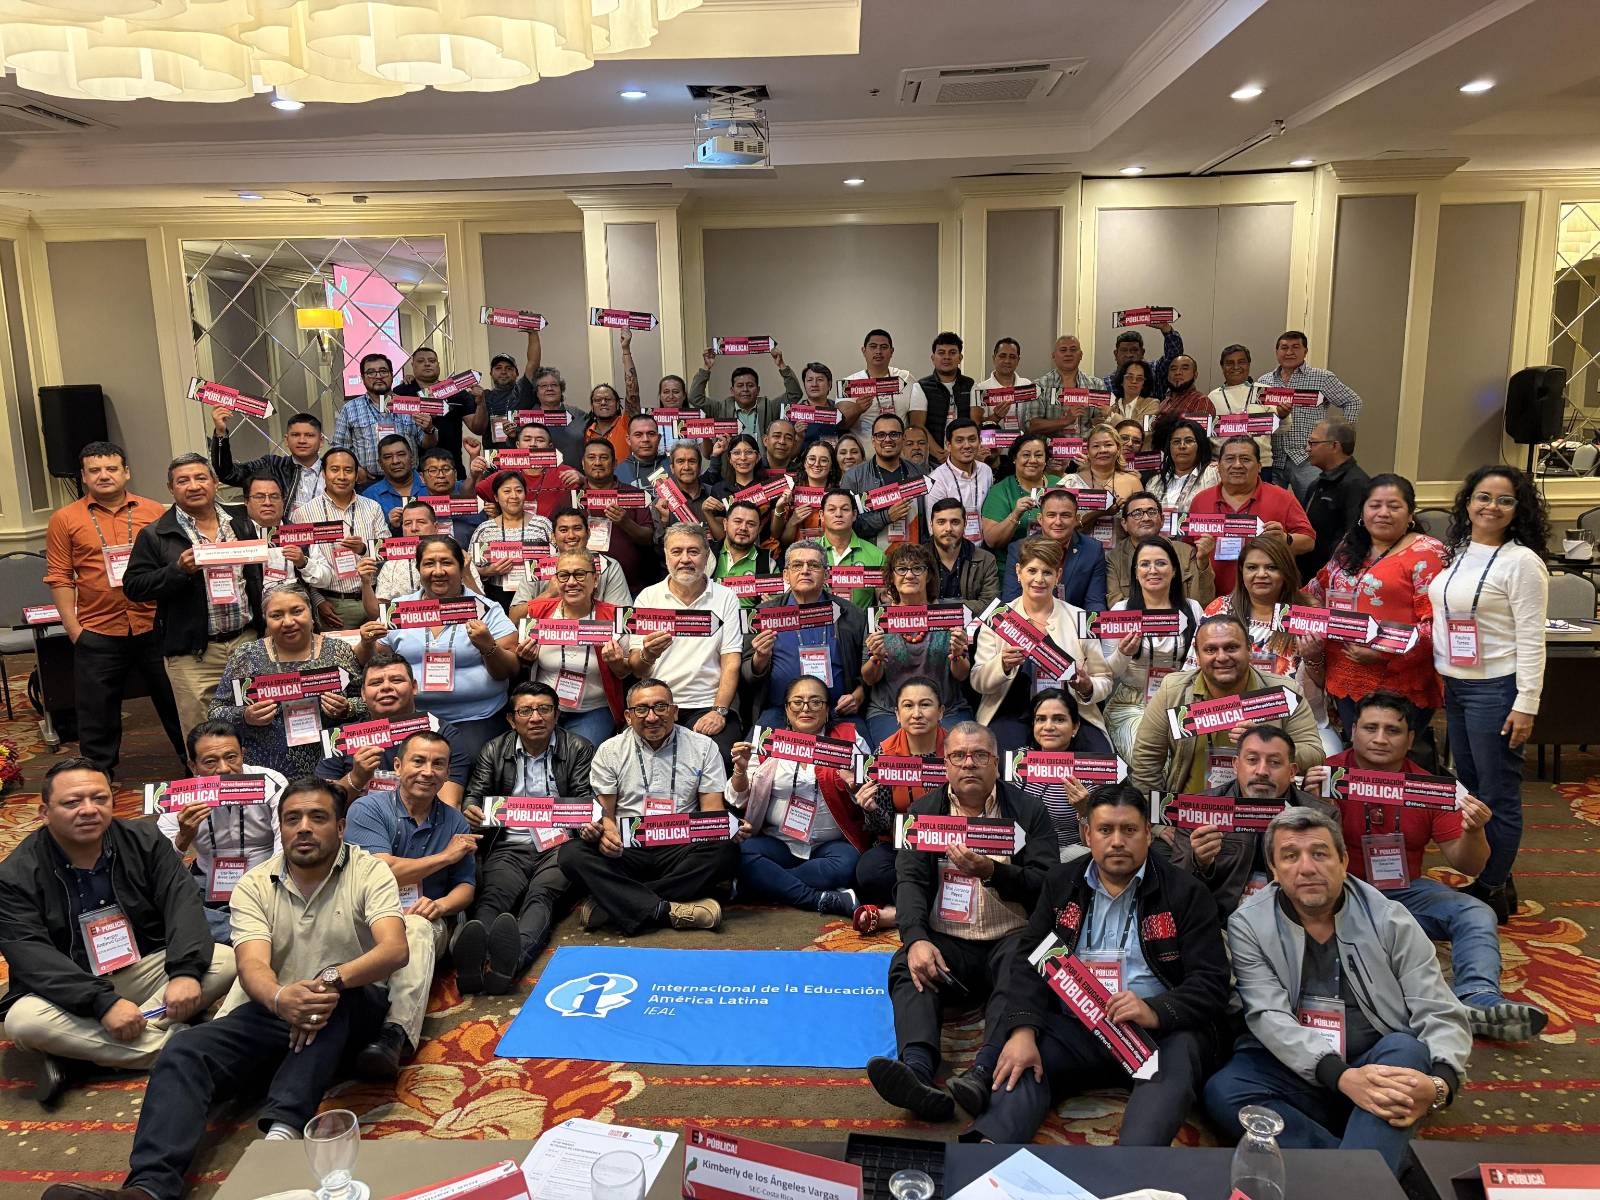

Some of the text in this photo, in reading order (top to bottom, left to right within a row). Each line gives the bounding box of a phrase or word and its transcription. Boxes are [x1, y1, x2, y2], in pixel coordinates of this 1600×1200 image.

[603, 315, 629, 326] PÚBLICA!
[724, 343, 749, 352] PÚBLICA!
[850, 385, 876, 395] PÚBLICA!
[203, 388, 236, 407] PÚBLICA!
[393, 402, 421, 413] PÚBLICA!
[791, 411, 815, 421] PÚBLICA!
[686, 425, 714, 436] PÚBLICA!
[1219, 424, 1248, 434] PÚBLICA!
[1052, 445, 1083, 455] PÚBLICA!
[500, 456, 530, 466] PÚBLICA!
[870, 492, 901, 506] PÚBLICA!
[434, 504, 450, 513] LICA!
[1189, 522, 1224, 533] PÚBLICA!
[279, 532, 314, 543] PÚBLICA!
[386, 547, 417, 556] PÚBLICA
[490, 549, 523, 559] PÚBLICA!
[832, 574, 864, 585] PÚBLICA!
[400, 610, 441, 624] PÚBLICA!
[761, 616, 800, 629] PÚBLICA!
[888, 615, 928, 628] PÚBLICA!
[636, 619, 676, 632] PÚBLICA!
[1100, 621, 1142, 634] PÚBLICA!
[1289, 617, 1328, 633] PÚBLICA!
[538, 629, 578, 641] PÚBLICA!
[999, 620, 1037, 653] PÚBLICA!
[257, 684, 302, 699] PÚBLICA!
[1194, 708, 1244, 730] PÚBLICA!
[345, 732, 391, 750] PÚBLICA!
[772, 741, 814, 758] PÚBLICA!
[878, 767, 922, 782] PÚBLICA!
[1027, 764, 1074, 778] PÚBLICA!
[1349, 781, 1404, 800] PÚBLICA!
[170, 790, 219, 806] PÚBLICA!
[506, 809, 552, 823] PÚBLICA!
[1178, 807, 1233, 826] PÚBLICA!
[645, 826, 690, 841] PÚBLICA!
[917, 829, 967, 846] PÚBLICA!
[1095, 969, 1119, 977] PÚBLICA!
[650, 983, 885, 996] Internacional de la Educación
[1052, 968, 1105, 1024] PÚBLICA!
[1081, 982, 1107, 1009] EDUCACIÓ
[648, 994, 769, 1006] América Latina
[643, 1006, 676, 1016] IEAL
[1313, 1018, 1341, 1029] PÚBLICA!
[706, 1137, 738, 1154] PÚBLICA!
[702, 1159, 840, 1200] Kimberly de los Ángeles Vargas
[1507, 1173, 1546, 1185] PÚBLICA!
[749, 1185, 781, 1199] SEC-Costa
